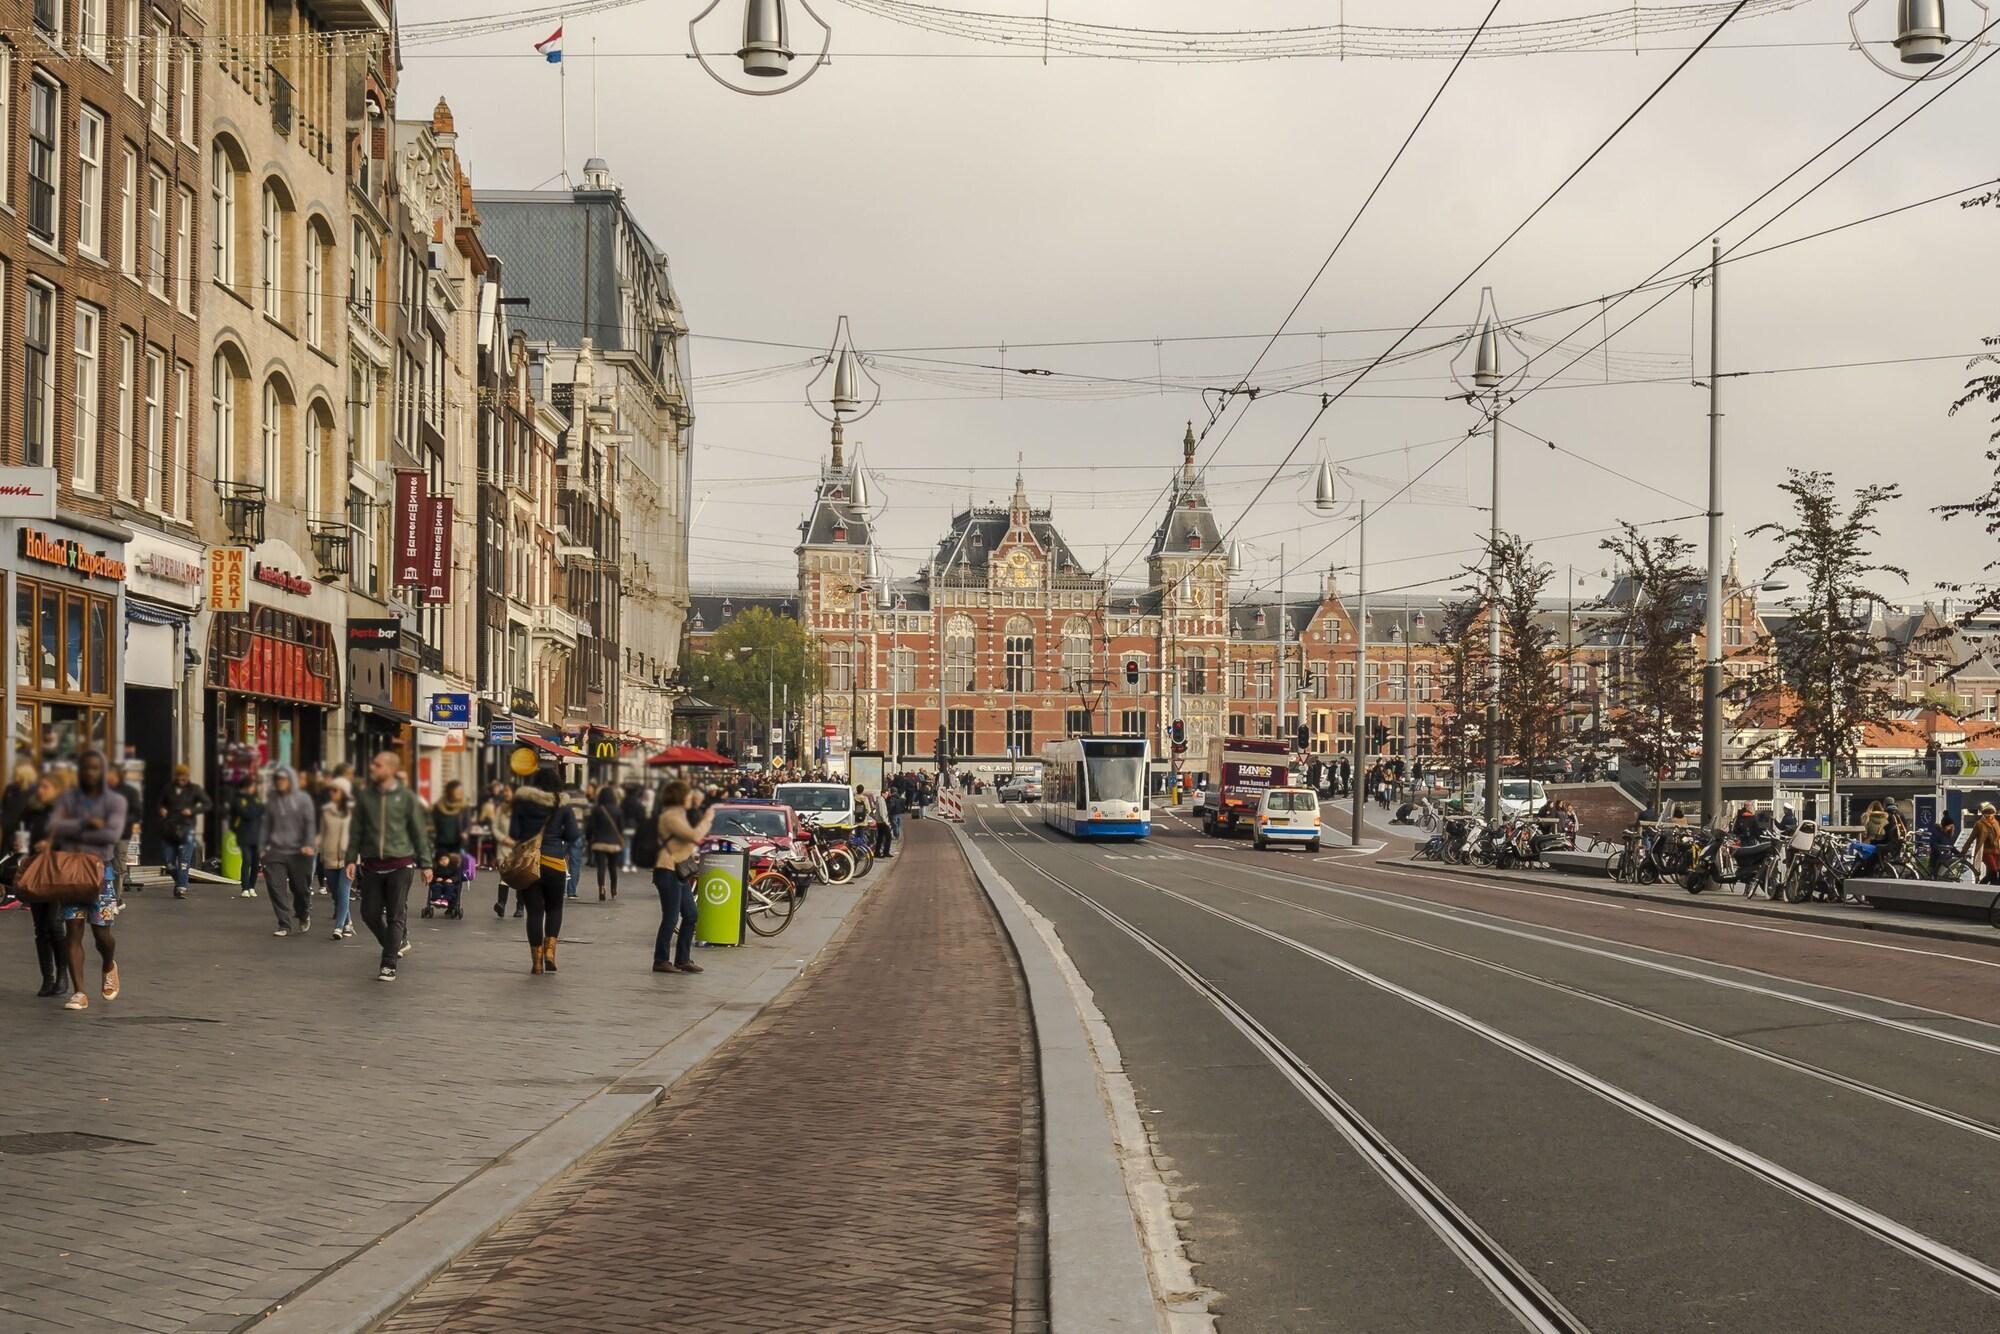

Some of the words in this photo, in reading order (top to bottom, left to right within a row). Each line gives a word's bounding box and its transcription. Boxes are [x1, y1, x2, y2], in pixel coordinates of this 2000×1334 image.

[26, 528, 67, 566] Holland
[78, 543, 126, 580] Experience
[150, 553, 205, 585] SUPERMARKET
[212, 550, 224, 608] SUPER
[229, 551, 242, 608] MARKT
